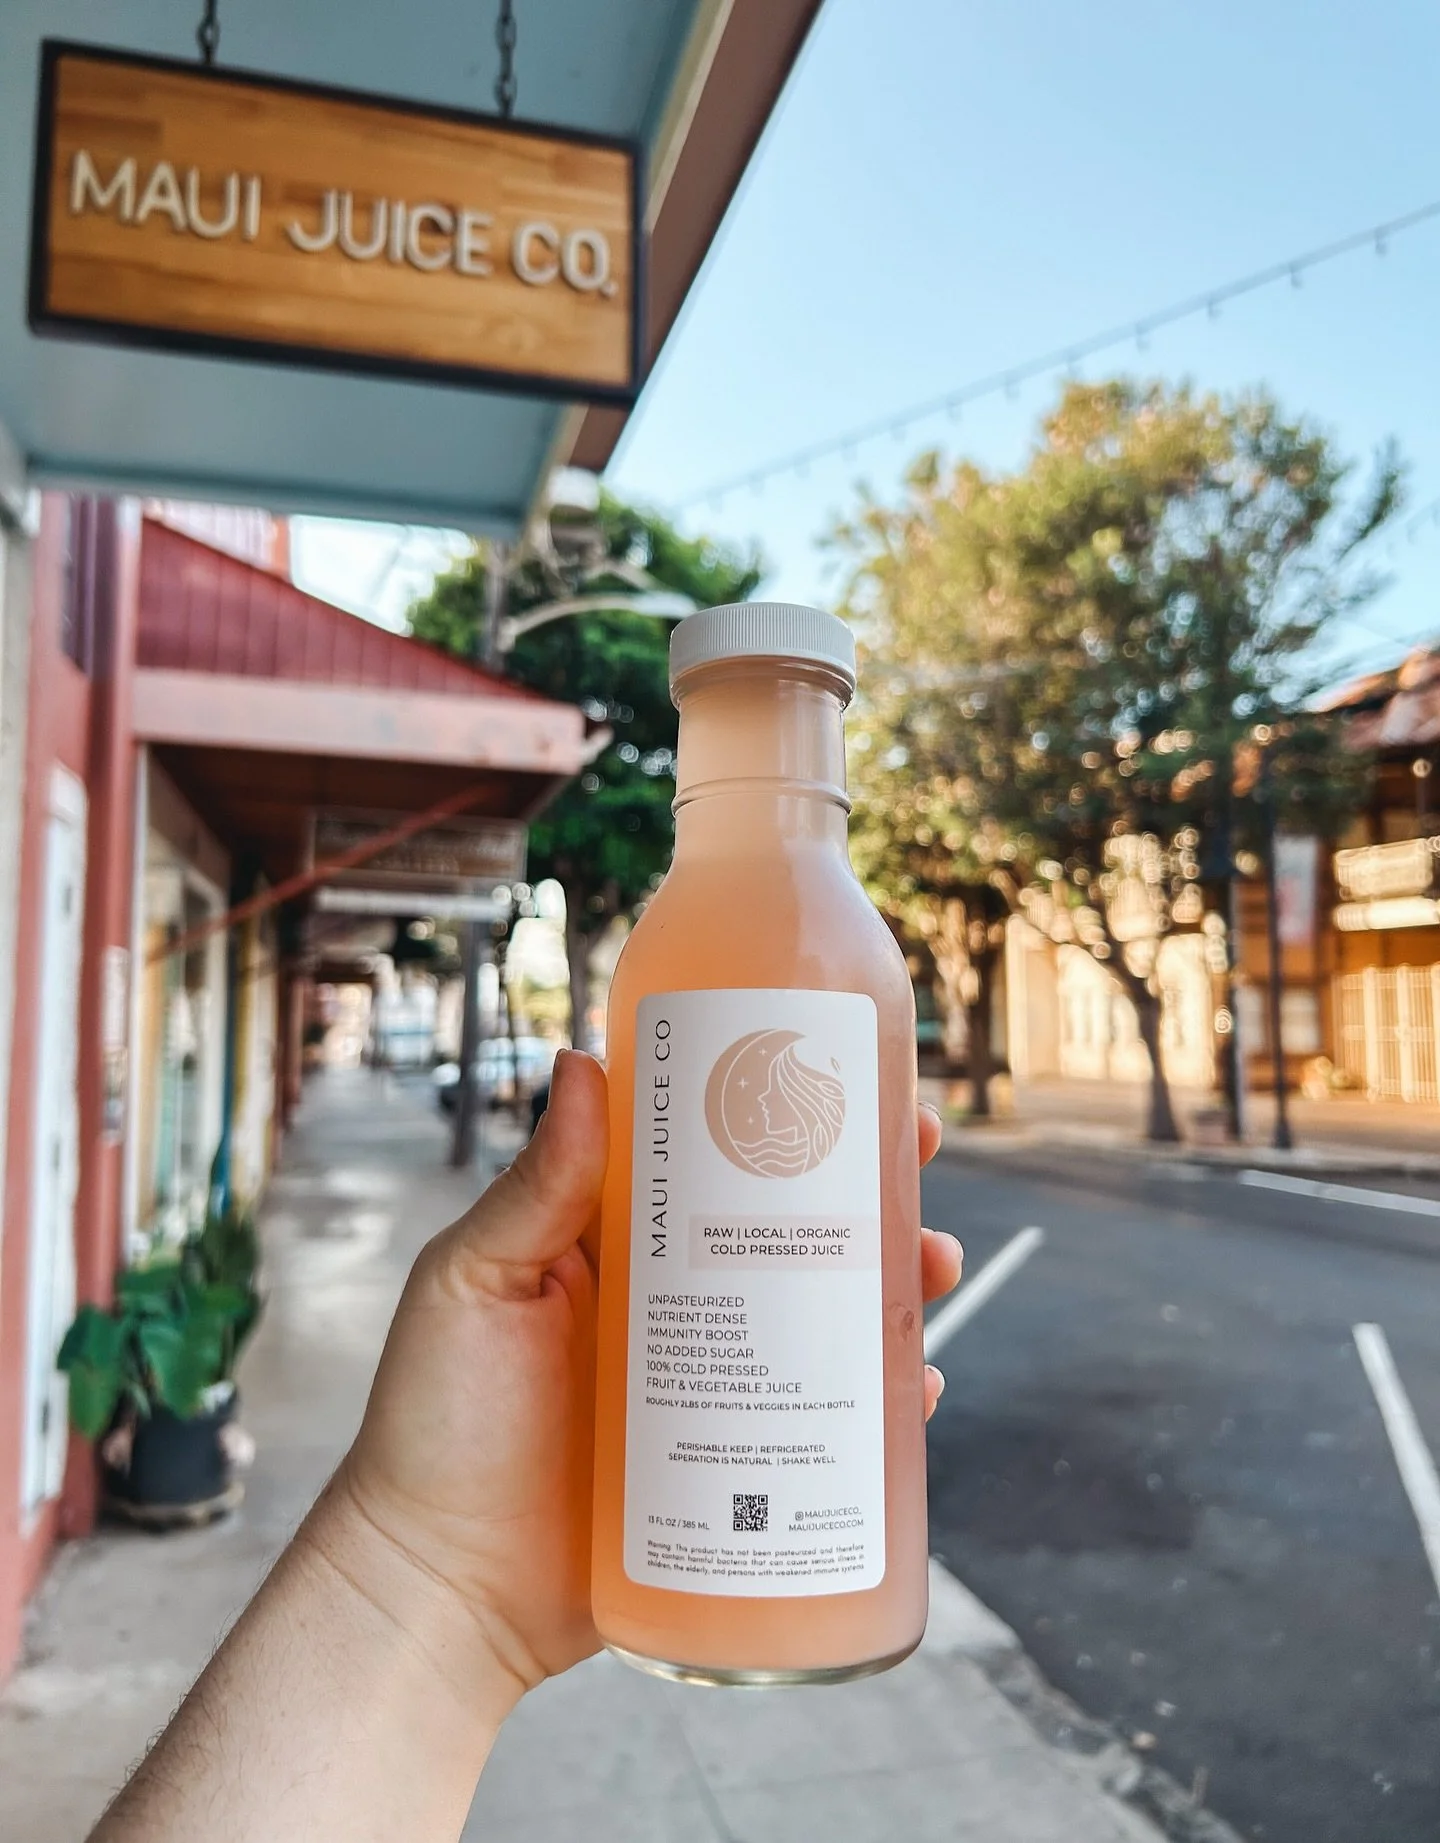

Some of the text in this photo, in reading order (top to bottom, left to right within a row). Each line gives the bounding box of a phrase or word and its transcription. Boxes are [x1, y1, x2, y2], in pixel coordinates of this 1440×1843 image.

[70, 149, 618, 295] MAUI JUICE CO.
[651, 1019, 671, 1257] MAUI JUICE CO
[704, 1228, 733, 1238] RAW
[744, 1228, 786, 1239] LOCAL
[797, 1228, 850, 1239] ORGANIC
[710, 1244, 844, 1256] COLD PRESSED JUICE
[648, 1294, 744, 1308] UNPASTEURIZED
[648, 1311, 748, 1324] NUTRIENT DENSE
[648, 1326, 748, 1341] IMMUNITY BOOST
[647, 1344, 754, 1358] NO ADDED SUGAR
[646, 1360, 768, 1376] 100% COLD PRESSED
[646, 1377, 802, 1394] FRUIT & VEGETABLE JUICE
[646, 1396, 855, 1410] ROUGHLY 2LBS OF FRUITS & VEGGIES IN EACH BOTTLE
[677, 1442, 728, 1452] PERISHABLE
[730, 1445, 753, 1453] KEEP
[760, 1444, 826, 1453] REFRIGERATED
[668, 1452, 719, 1464] SEPERATION
[732, 1457, 772, 1465] NATURAL
[782, 1456, 810, 1464] SHAKE
[813, 1456, 836, 1464] WELL
[656, 1516, 664, 1525] FL
[666, 1518, 676, 1527] OZ
[698, 1522, 710, 1530] ML
[690, 1547, 718, 1556] product
[688, 1555, 714, 1564] harmful
[716, 1556, 748, 1566] bacteria
[752, 1558, 766, 1566] that
[674, 1562, 684, 1571] the
[728, 1568, 756, 1576] persons
